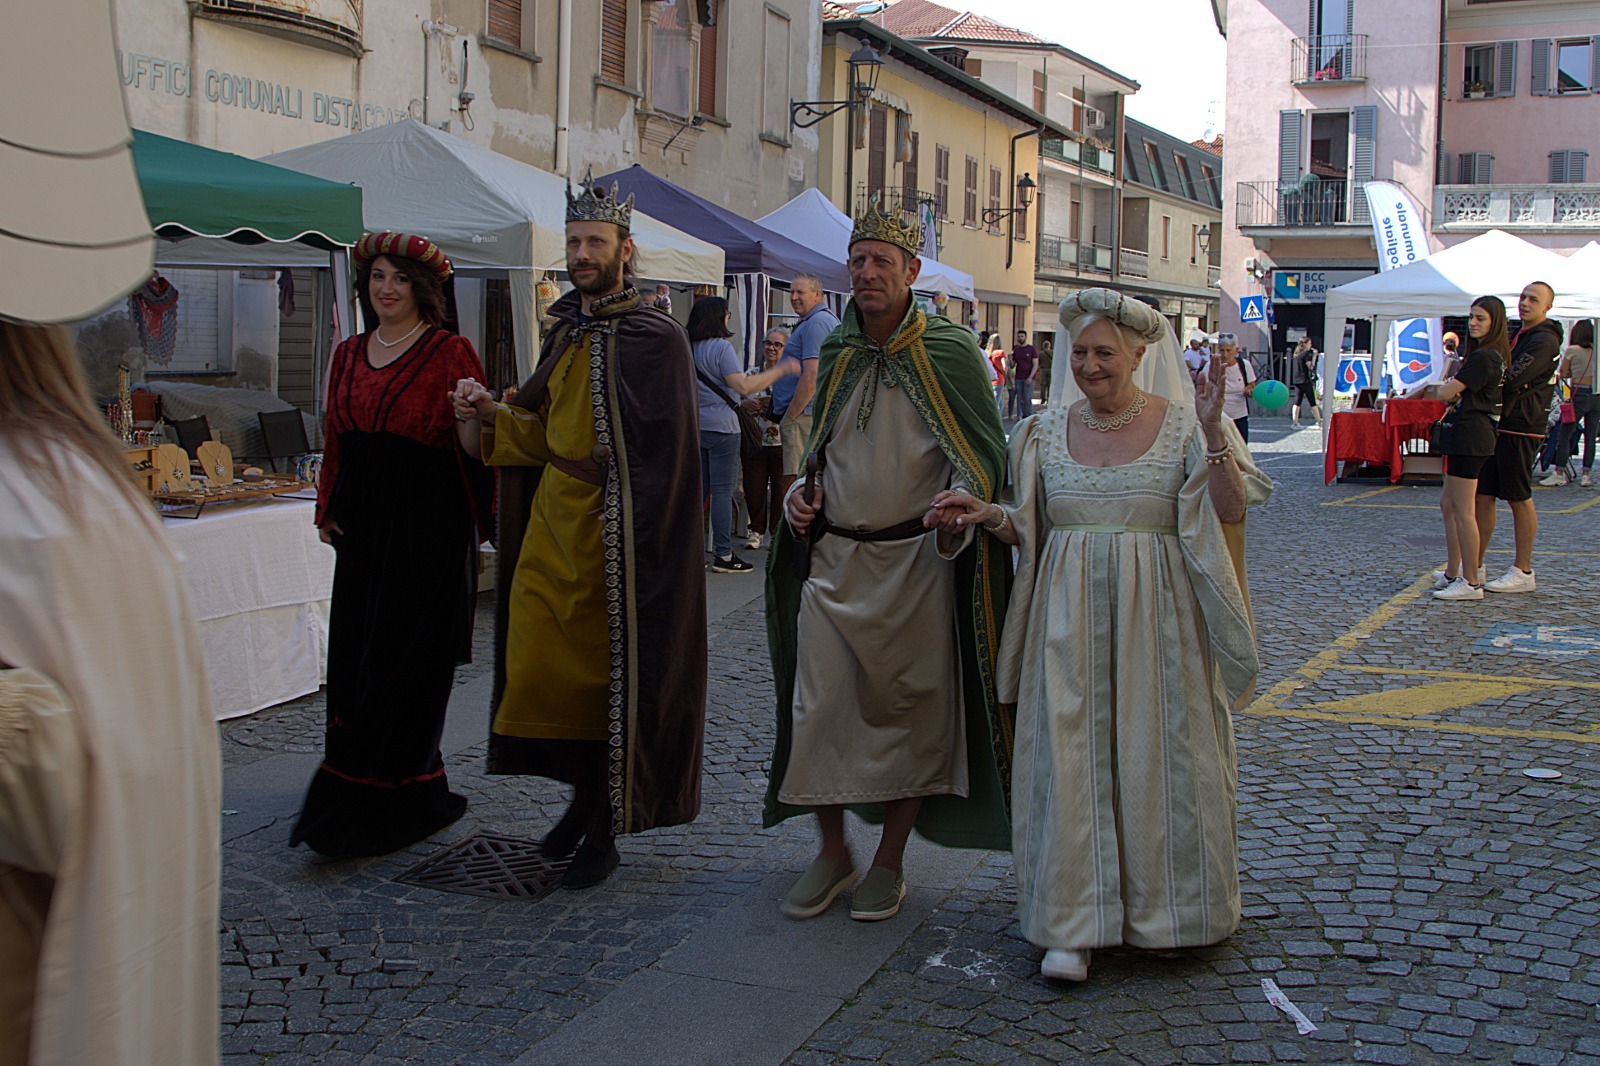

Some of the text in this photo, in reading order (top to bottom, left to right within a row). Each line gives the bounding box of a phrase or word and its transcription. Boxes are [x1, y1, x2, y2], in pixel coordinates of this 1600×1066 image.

[119, 51, 191, 97] UFFICI
[205, 69, 302, 119] COMUNALI
[1304, 272, 1325, 282] BCC
